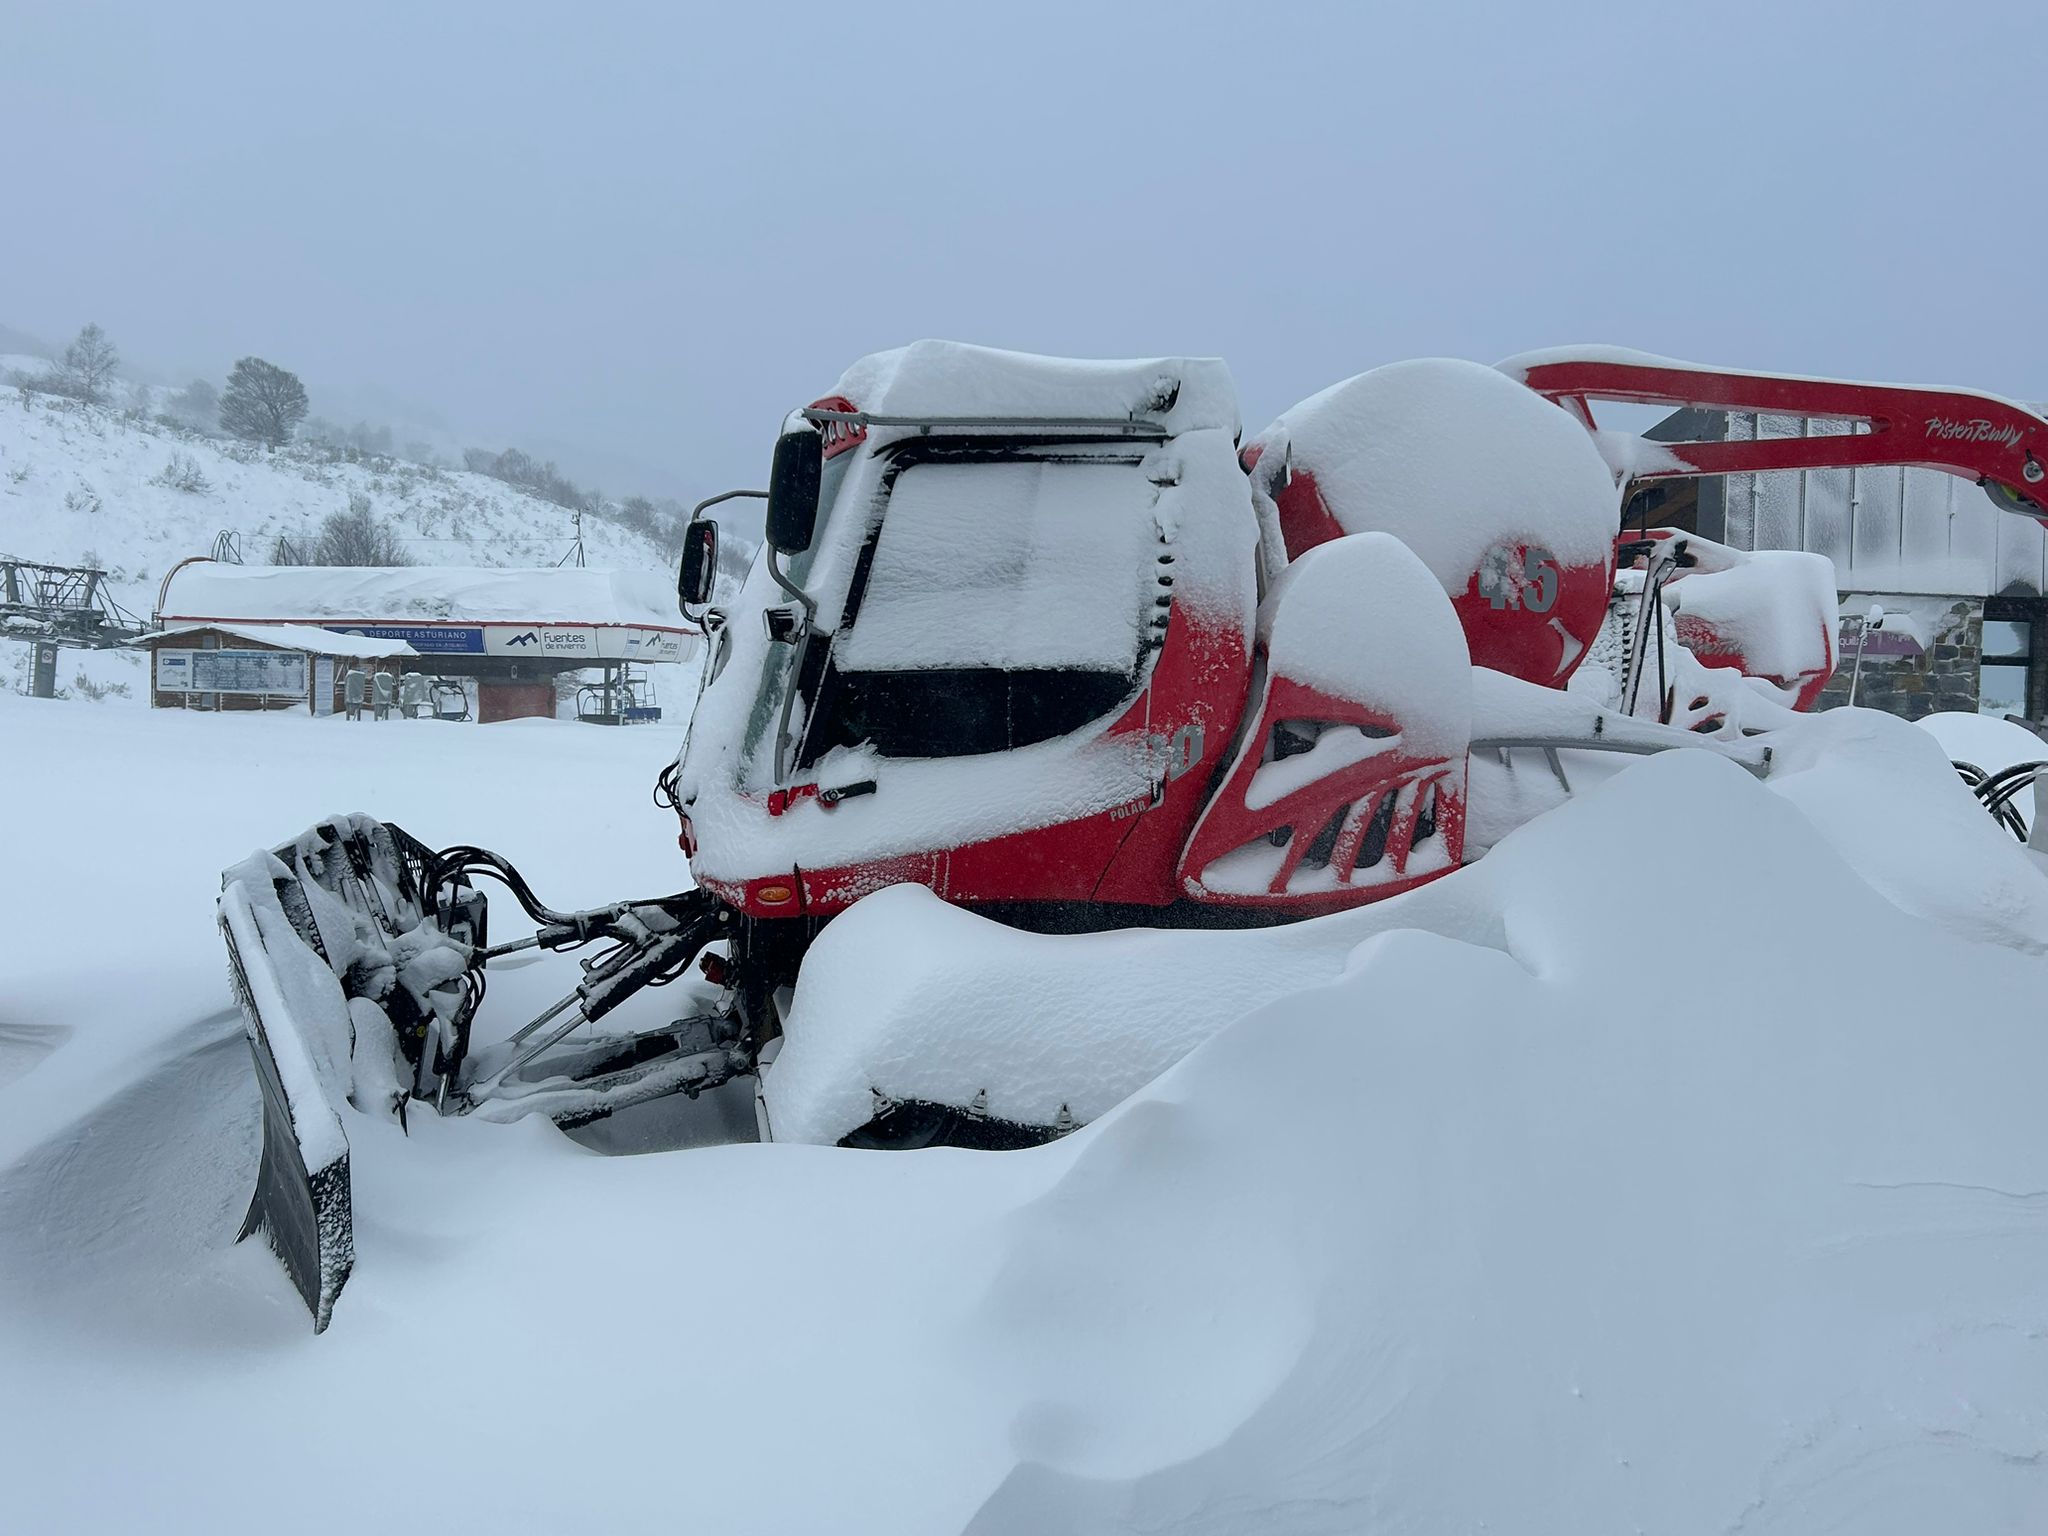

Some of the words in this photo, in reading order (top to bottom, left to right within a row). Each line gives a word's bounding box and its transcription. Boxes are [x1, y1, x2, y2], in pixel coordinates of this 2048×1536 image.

[1925, 417, 2023, 448] PistenBully
[1478, 546, 1558, 613] 4.5
[369, 630, 411, 639] DEPORTE
[414, 630, 467, 639] ASTURIANO
[544, 632, 586, 643] Fuentes
[545, 642, 555, 650] de
[556, 642, 587, 650] invierno
[1110, 800, 1146, 822] POLAR
